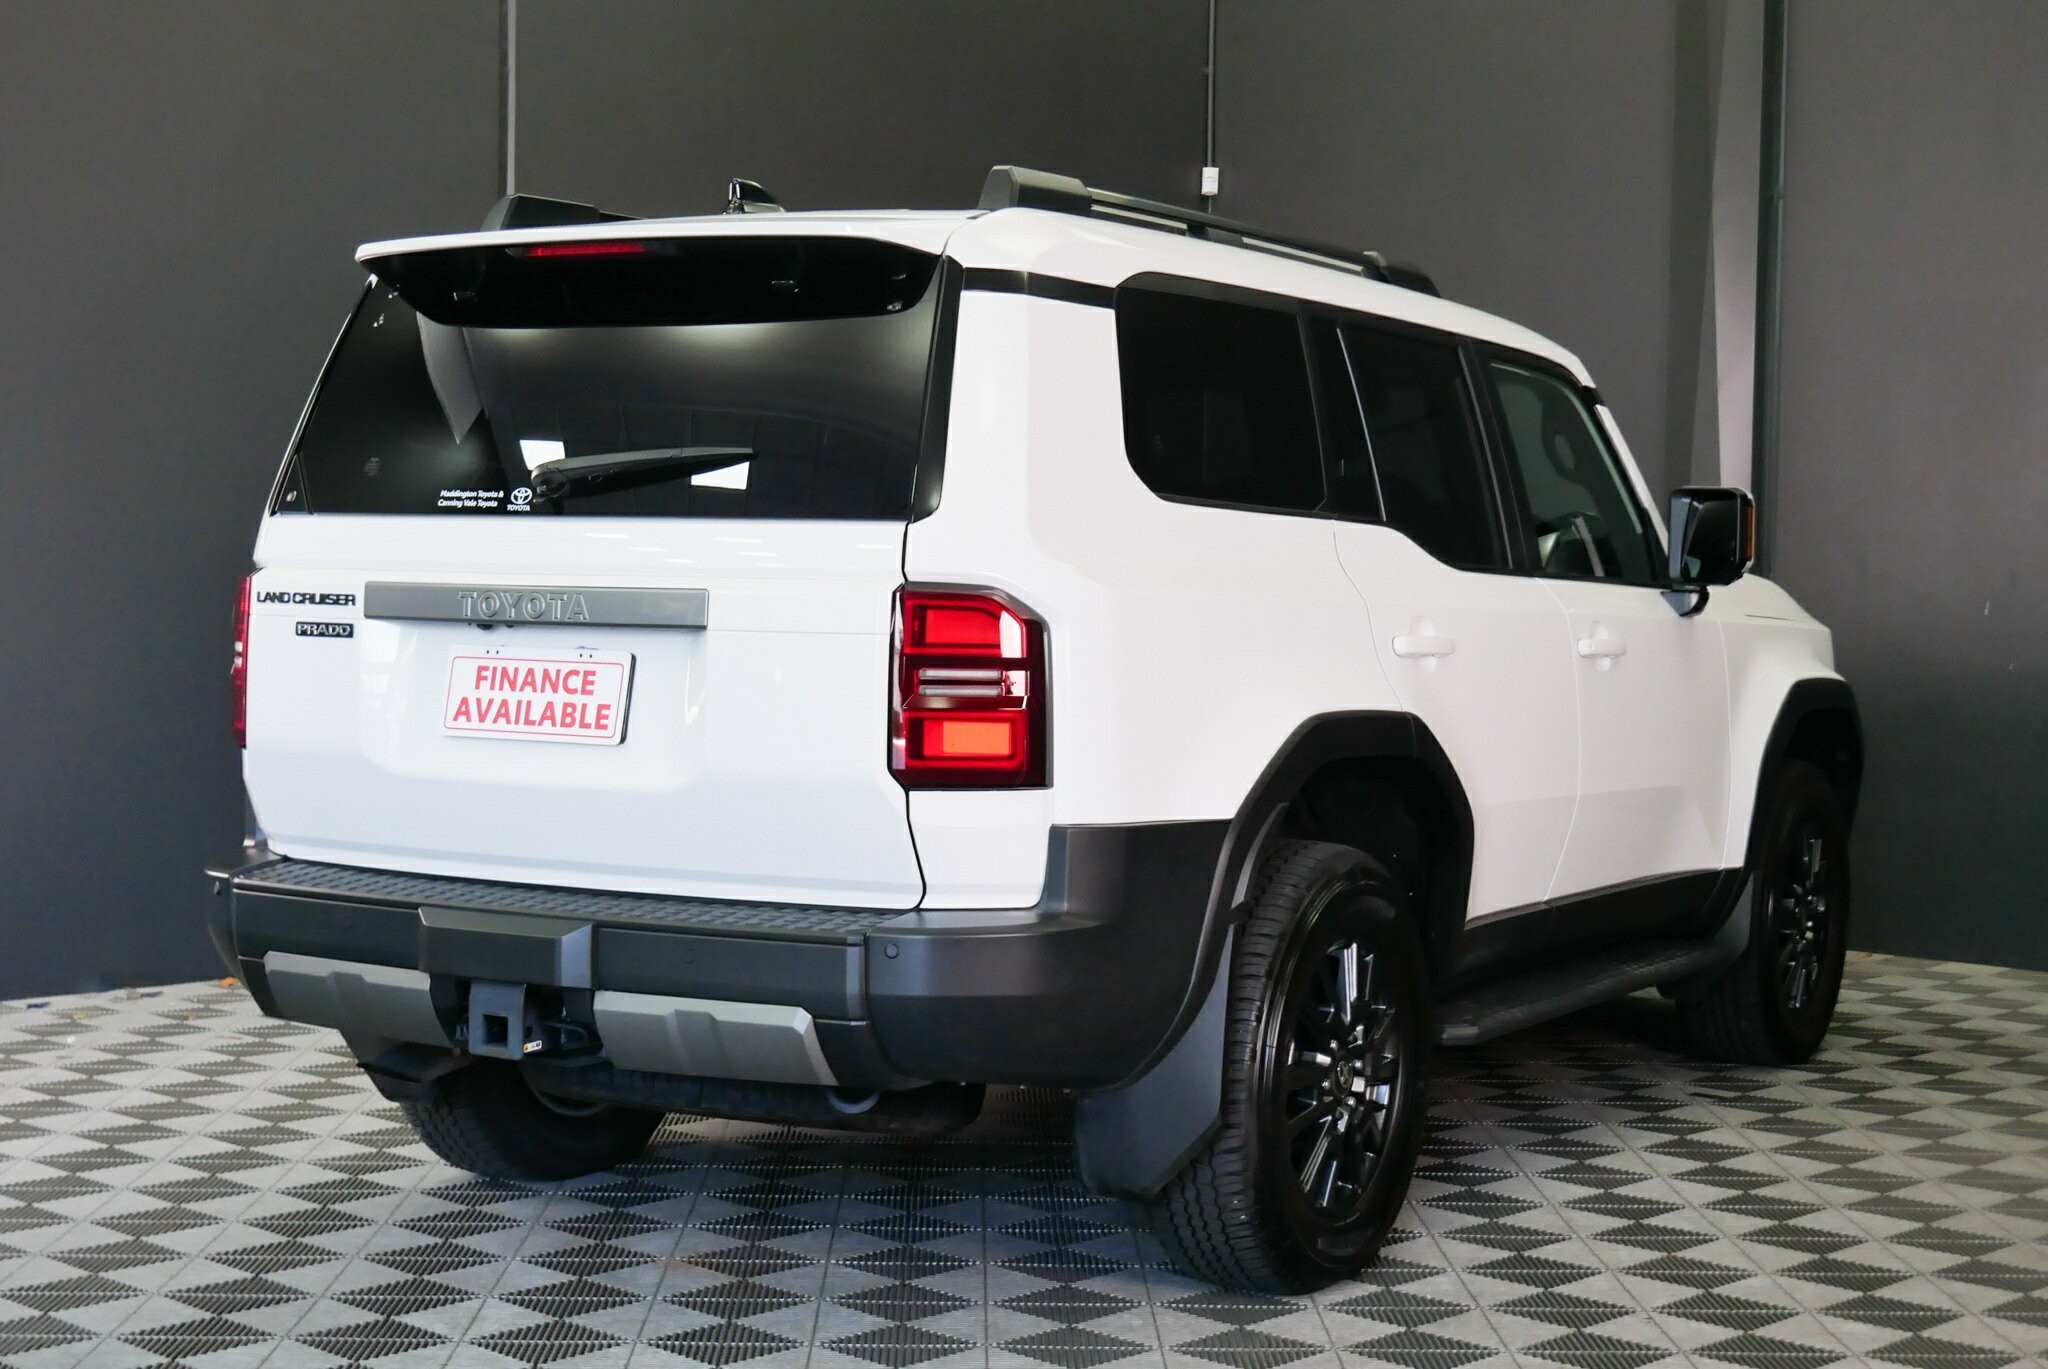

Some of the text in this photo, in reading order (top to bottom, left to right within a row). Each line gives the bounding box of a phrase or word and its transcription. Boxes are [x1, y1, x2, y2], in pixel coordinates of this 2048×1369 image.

[440, 489, 477, 499] Maddington
[478, 490, 498, 499] Toyota
[438, 499, 498, 508] Canning Vale Toyota
[257, 592, 356, 606] LAND CRUISER
[458, 591, 590, 621] TOYOTA
[297, 623, 351, 635] PRADO
[474, 665, 597, 696] FINANCE
[452, 696, 611, 731] AVAILABLE
